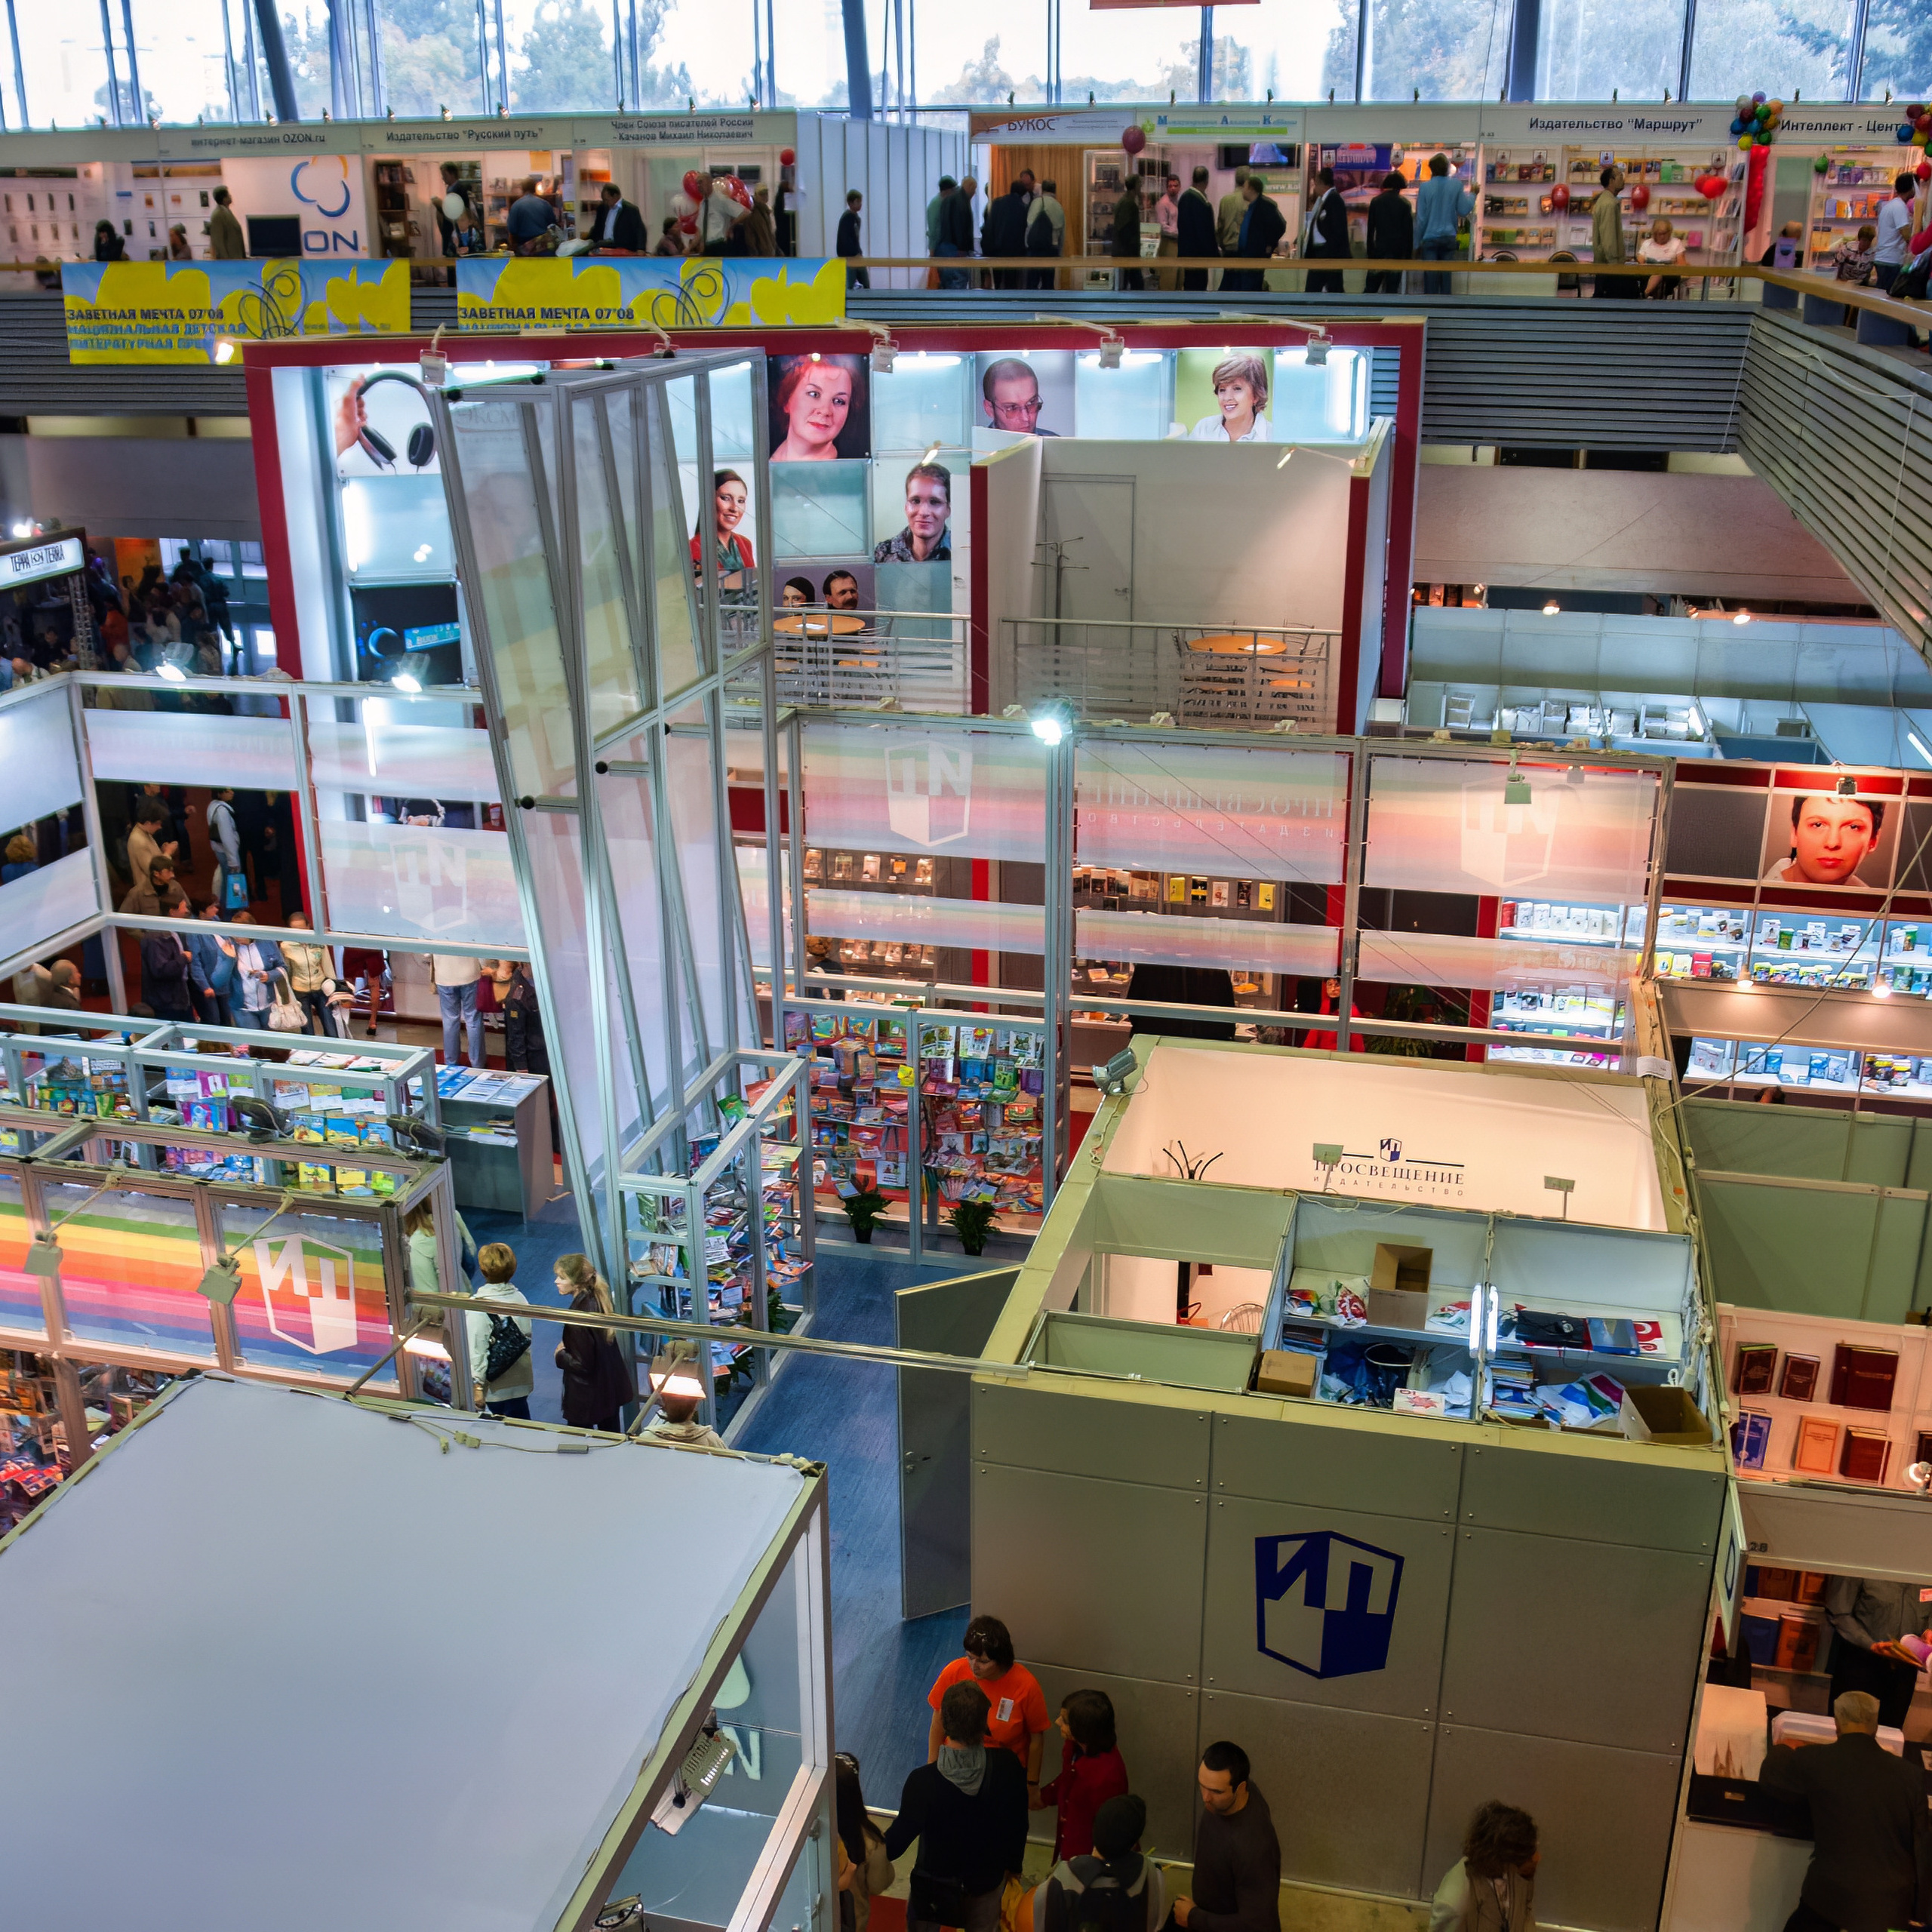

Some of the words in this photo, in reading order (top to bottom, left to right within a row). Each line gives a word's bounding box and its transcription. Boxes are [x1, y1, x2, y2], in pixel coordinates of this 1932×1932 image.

[611, 120, 634, 129] Член
[637, 119, 667, 129] Союза
[669, 118, 717, 128] писателей
[720, 118, 753, 127] России
[1529, 117, 1623, 131] Издательство
[1627, 117, 1703, 133] "Маршрут"
[282, 133, 325, 144] OZON.ru
[386, 131, 460, 142] Издательство
[618, 131, 659, 141] Качанов
[660, 131, 694, 140] Михаил
[697, 130, 753, 140] Николаевич
[66, 309, 136, 321] ЗАВЕТНАЯ
[140, 308, 185, 320] МЕЧТА
[459, 307, 536, 320] ЗАВЕТНАЯ
[540, 307, 590, 320] МЕЧТА
